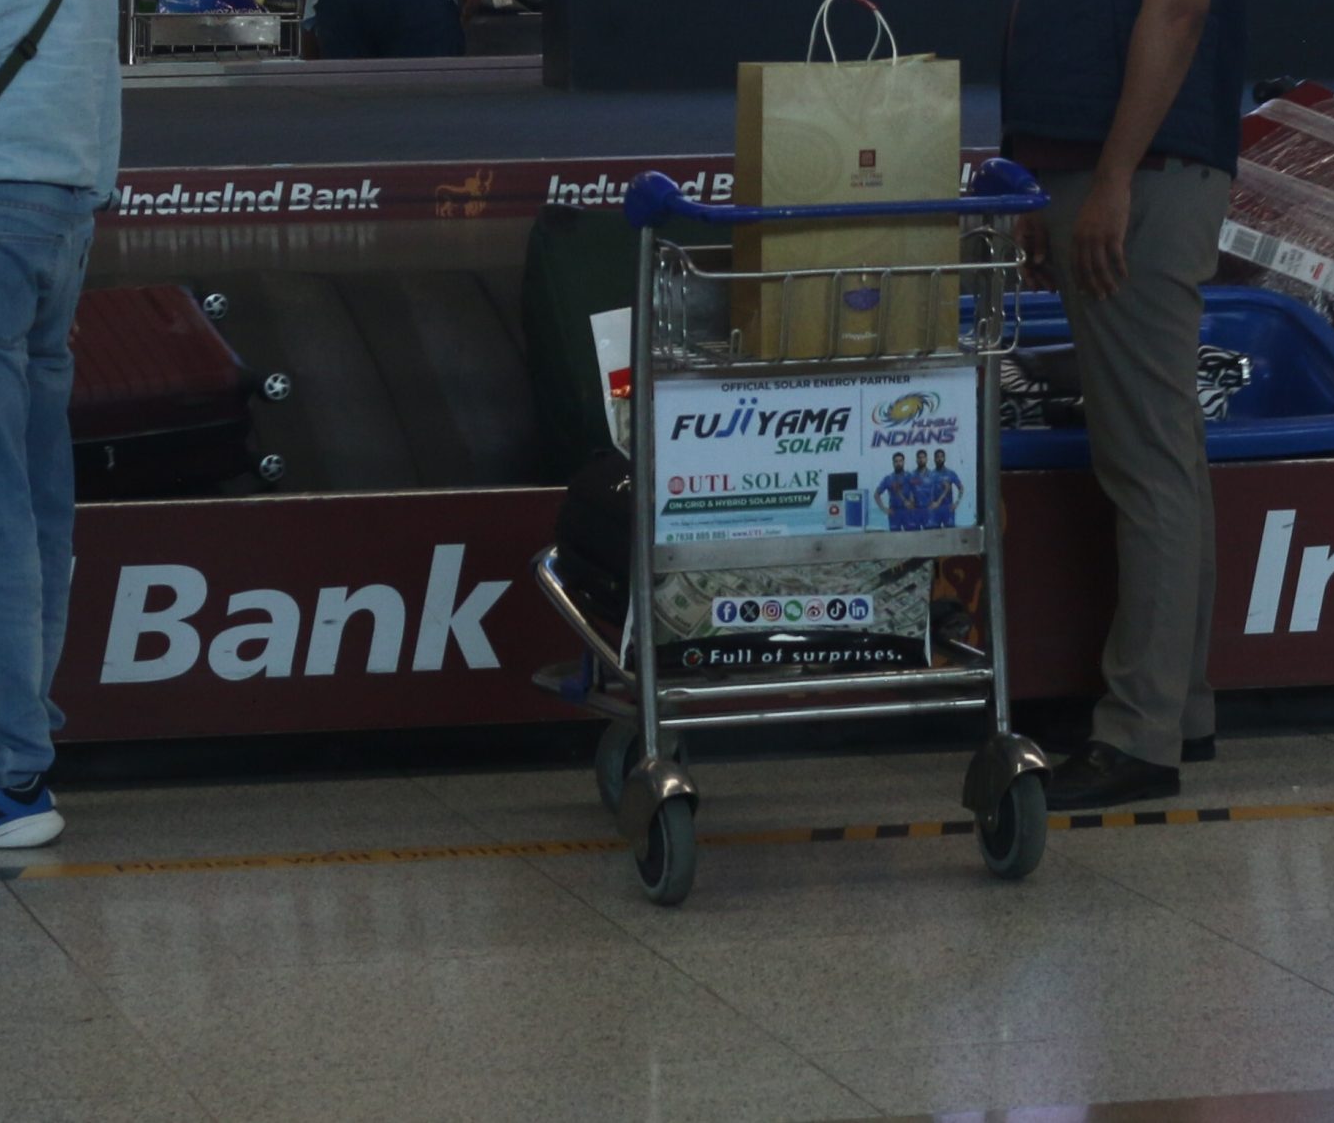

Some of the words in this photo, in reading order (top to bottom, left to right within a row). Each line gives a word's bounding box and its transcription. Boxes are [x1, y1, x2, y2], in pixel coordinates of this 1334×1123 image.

[118, 181, 284, 217] IndusInd
[288, 179, 381, 212] Bank
[720, 381, 771, 393] OFFICIAL
[773, 379, 811, 390] SOLAR
[813, 377, 857, 388] ENERGY
[859, 375, 910, 386] PARTNER
[775, 435, 844, 455] SOLAR
[870, 427, 958, 449] INDIANS
[688, 474, 735, 493] UTL
[742, 470, 821, 490] SOLAR
[669, 500, 706, 510] ON-GRID
[707, 500, 714, 509] &
[715, 498, 747, 508] HYBRID
[749, 497, 777, 506] SOLAR
[778, 495, 811, 504] SYSTEM
[100, 544, 512, 684] Bank
[710, 649, 751, 664] Full
[762, 648, 782, 663] of
[792, 649, 903, 668] surprises.
